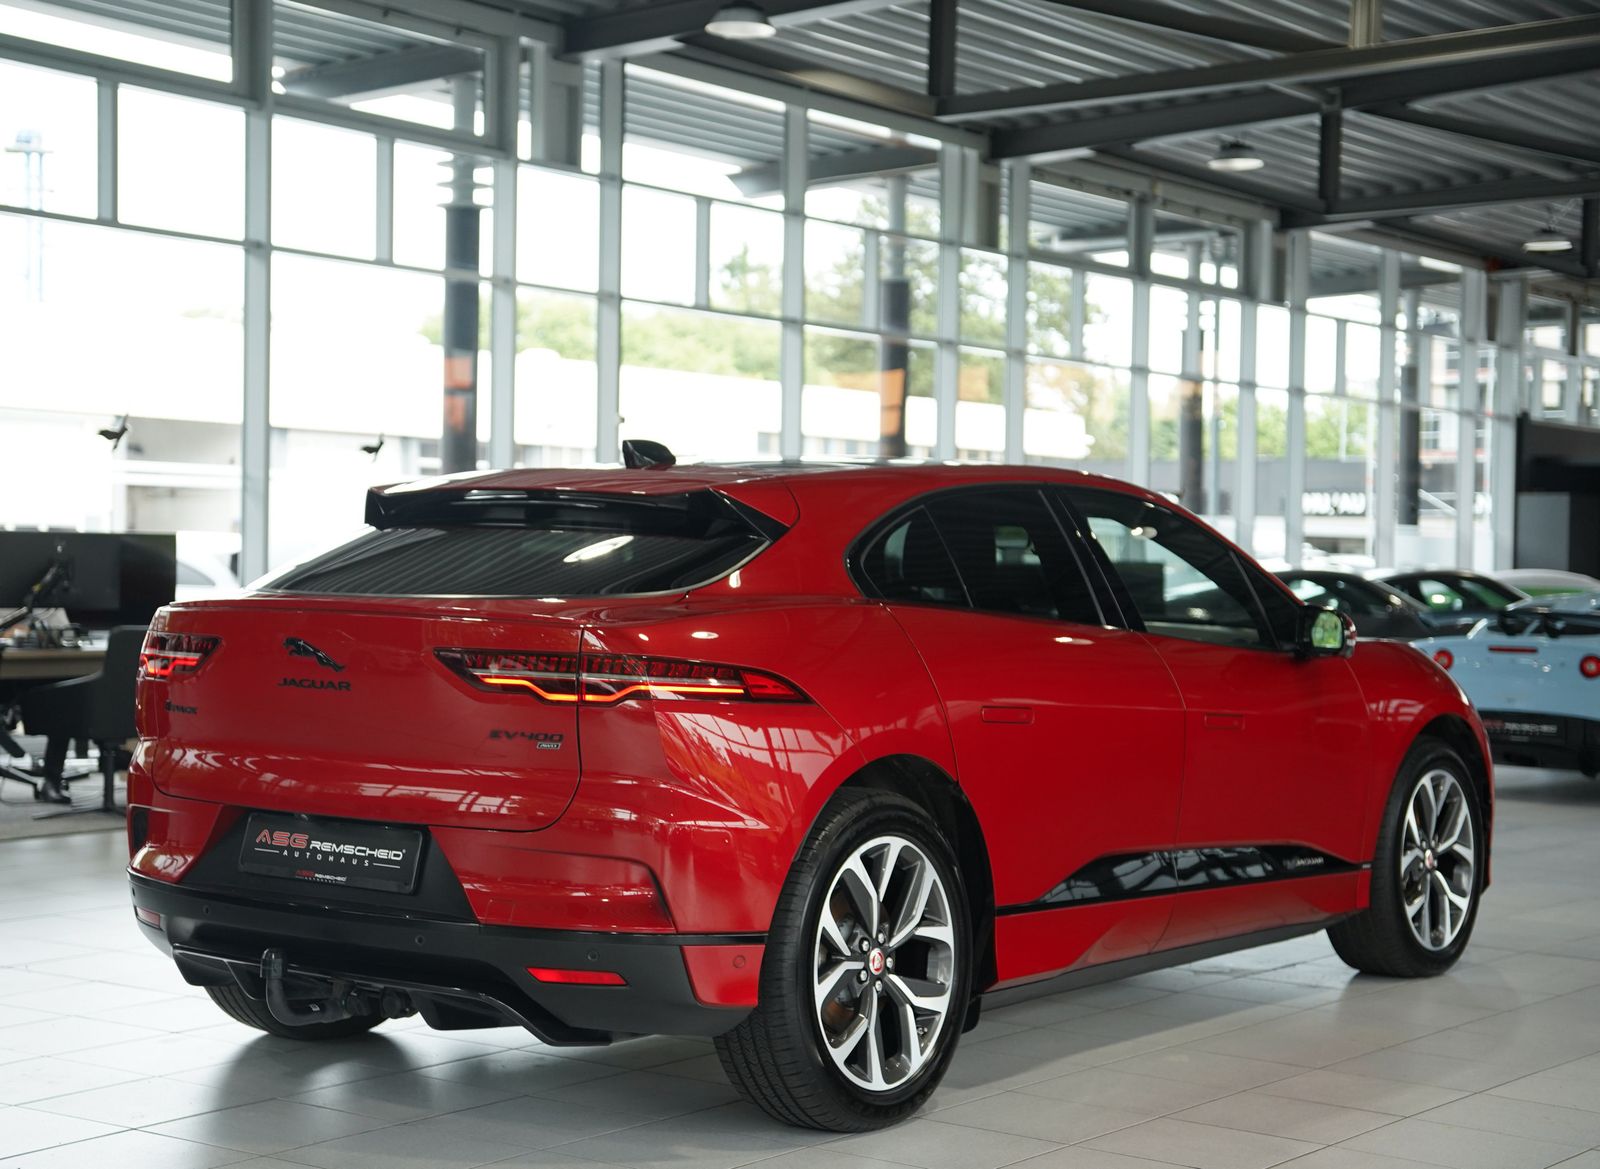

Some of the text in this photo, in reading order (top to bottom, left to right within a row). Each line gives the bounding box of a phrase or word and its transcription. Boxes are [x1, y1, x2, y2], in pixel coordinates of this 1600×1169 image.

[277, 678, 352, 691] JAGUAR
[489, 729, 564, 742] EV400
[255, 829, 403, 861] ASG REMSCHEID
[283, 850, 369, 867] AUTOHAUS
